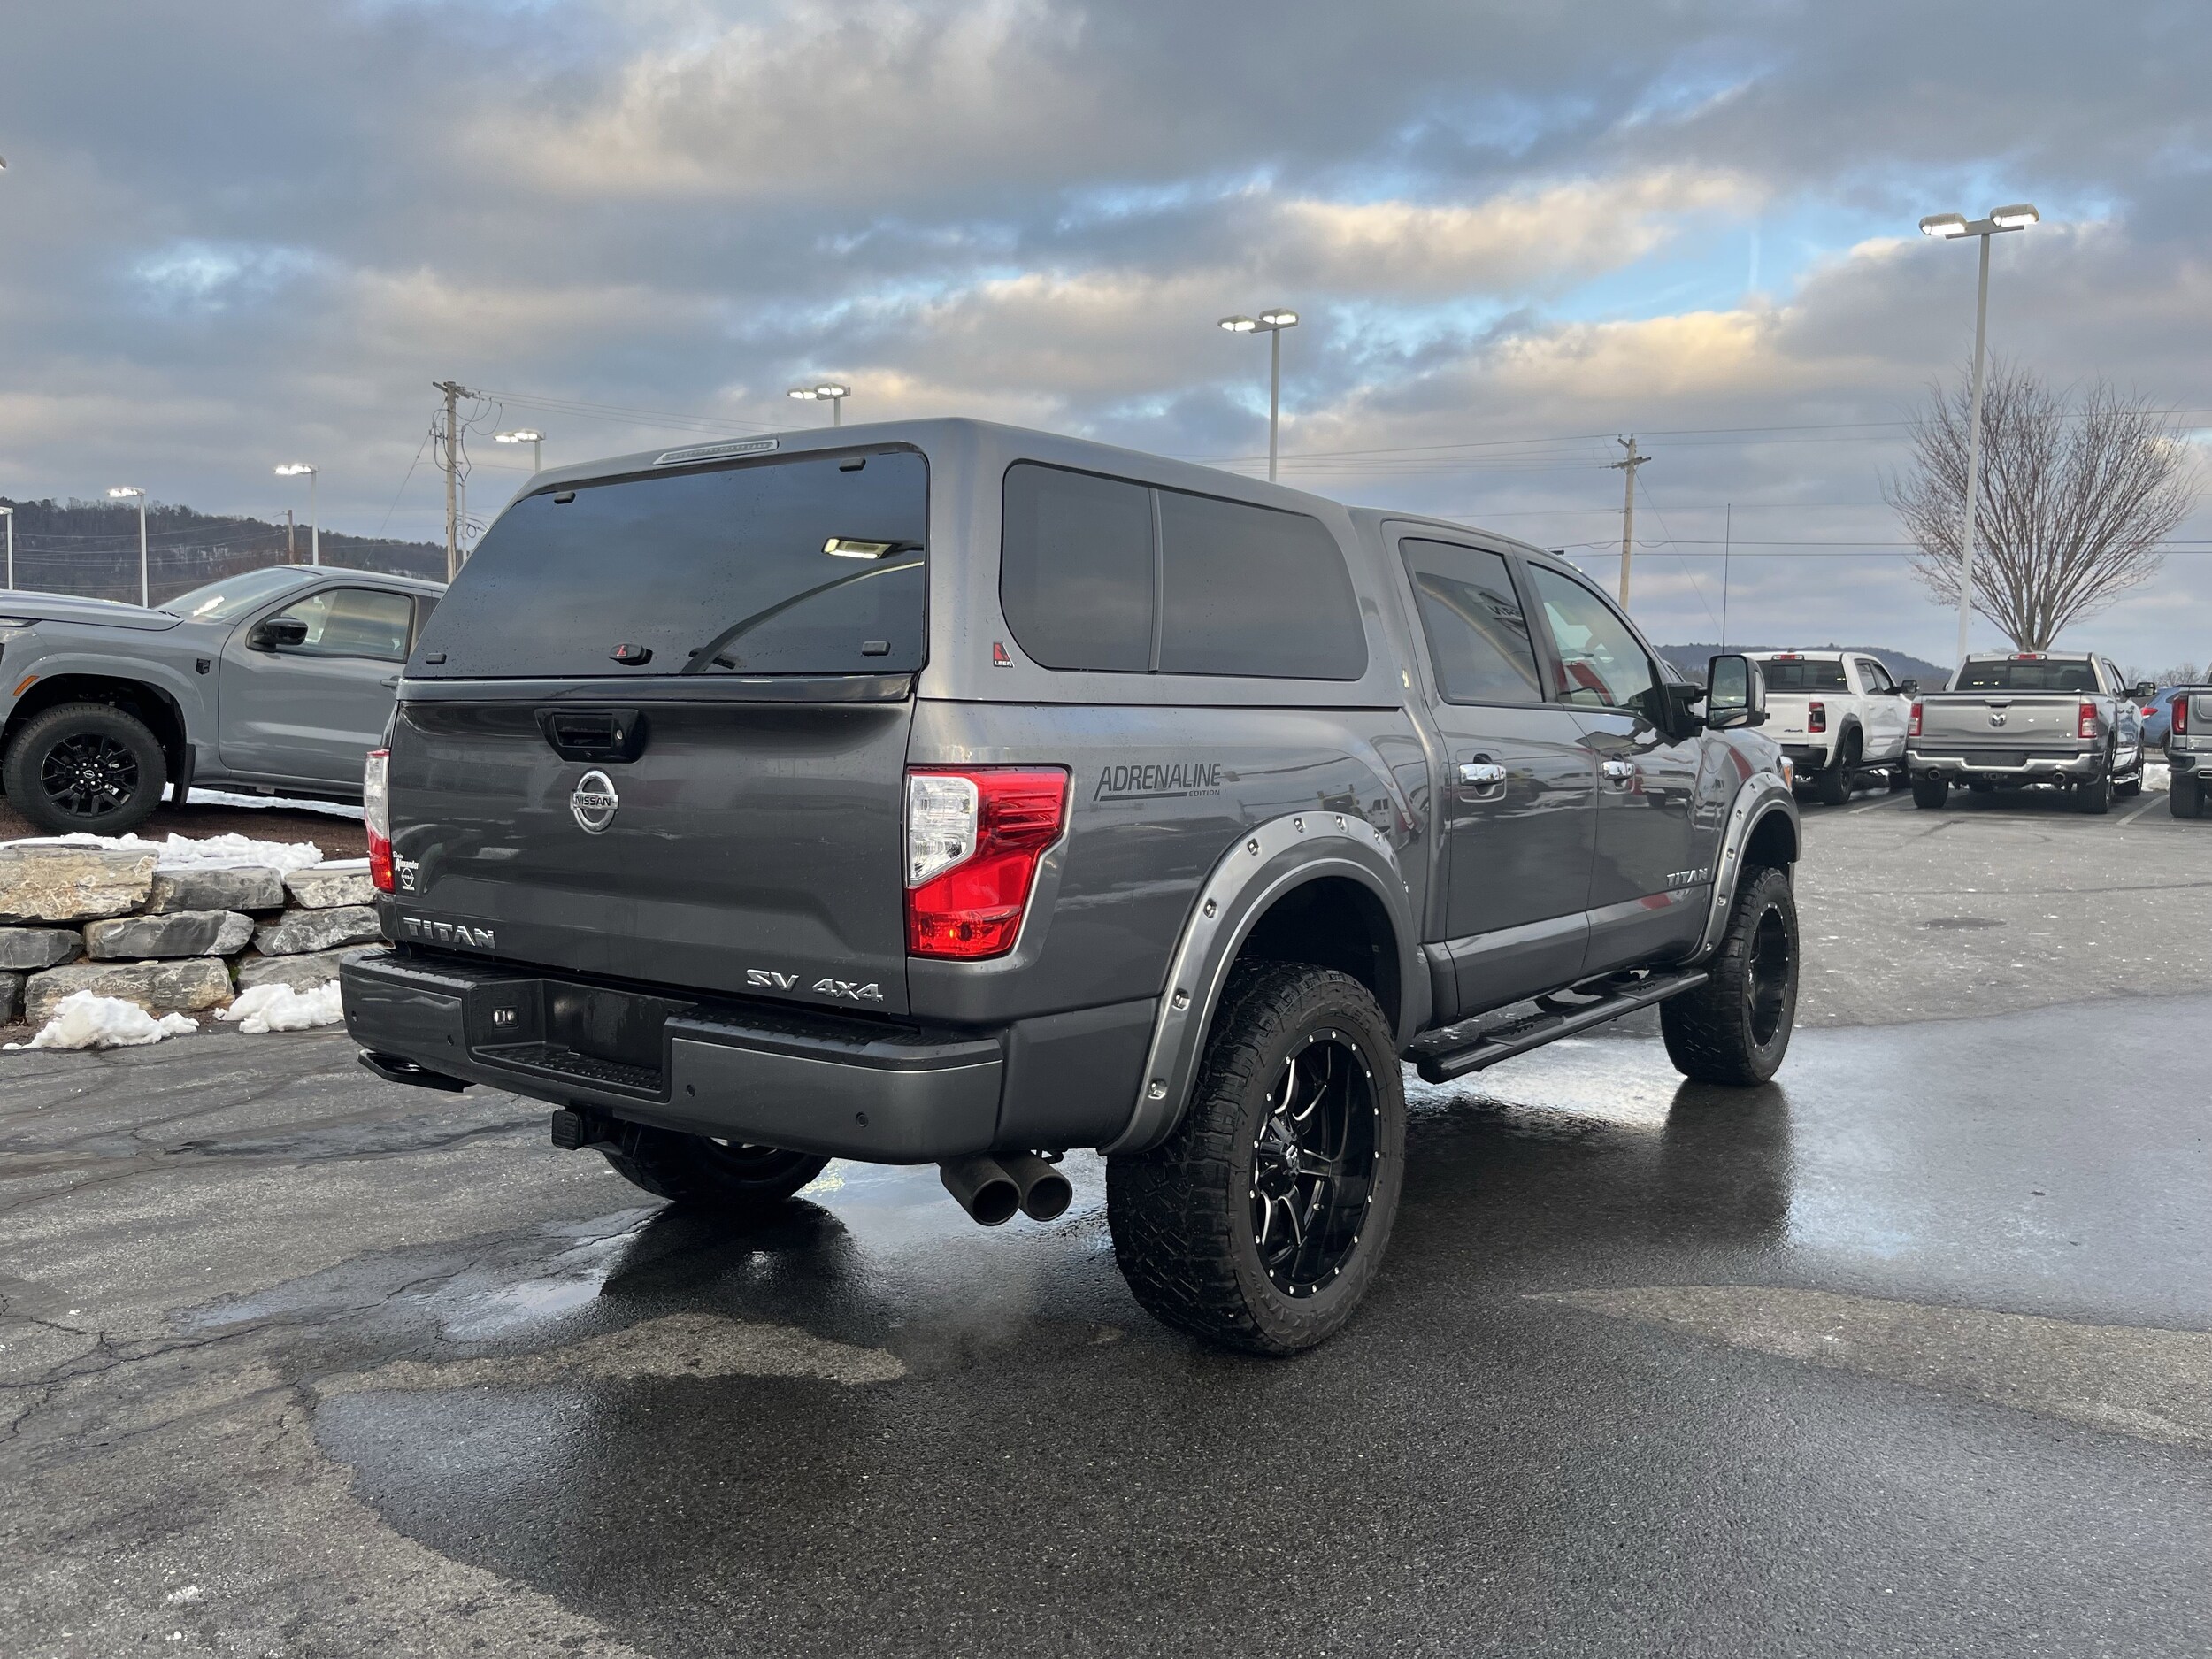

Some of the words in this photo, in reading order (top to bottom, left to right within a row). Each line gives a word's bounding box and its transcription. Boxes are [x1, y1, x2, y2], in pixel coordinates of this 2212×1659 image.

[1093, 763, 1221, 802] ADRENALINE
[575, 795, 611, 807] NISSAN
[1666, 867, 1708, 887] TITAN
[403, 917, 495, 949] TITAN
[746, 969, 800, 992] SV
